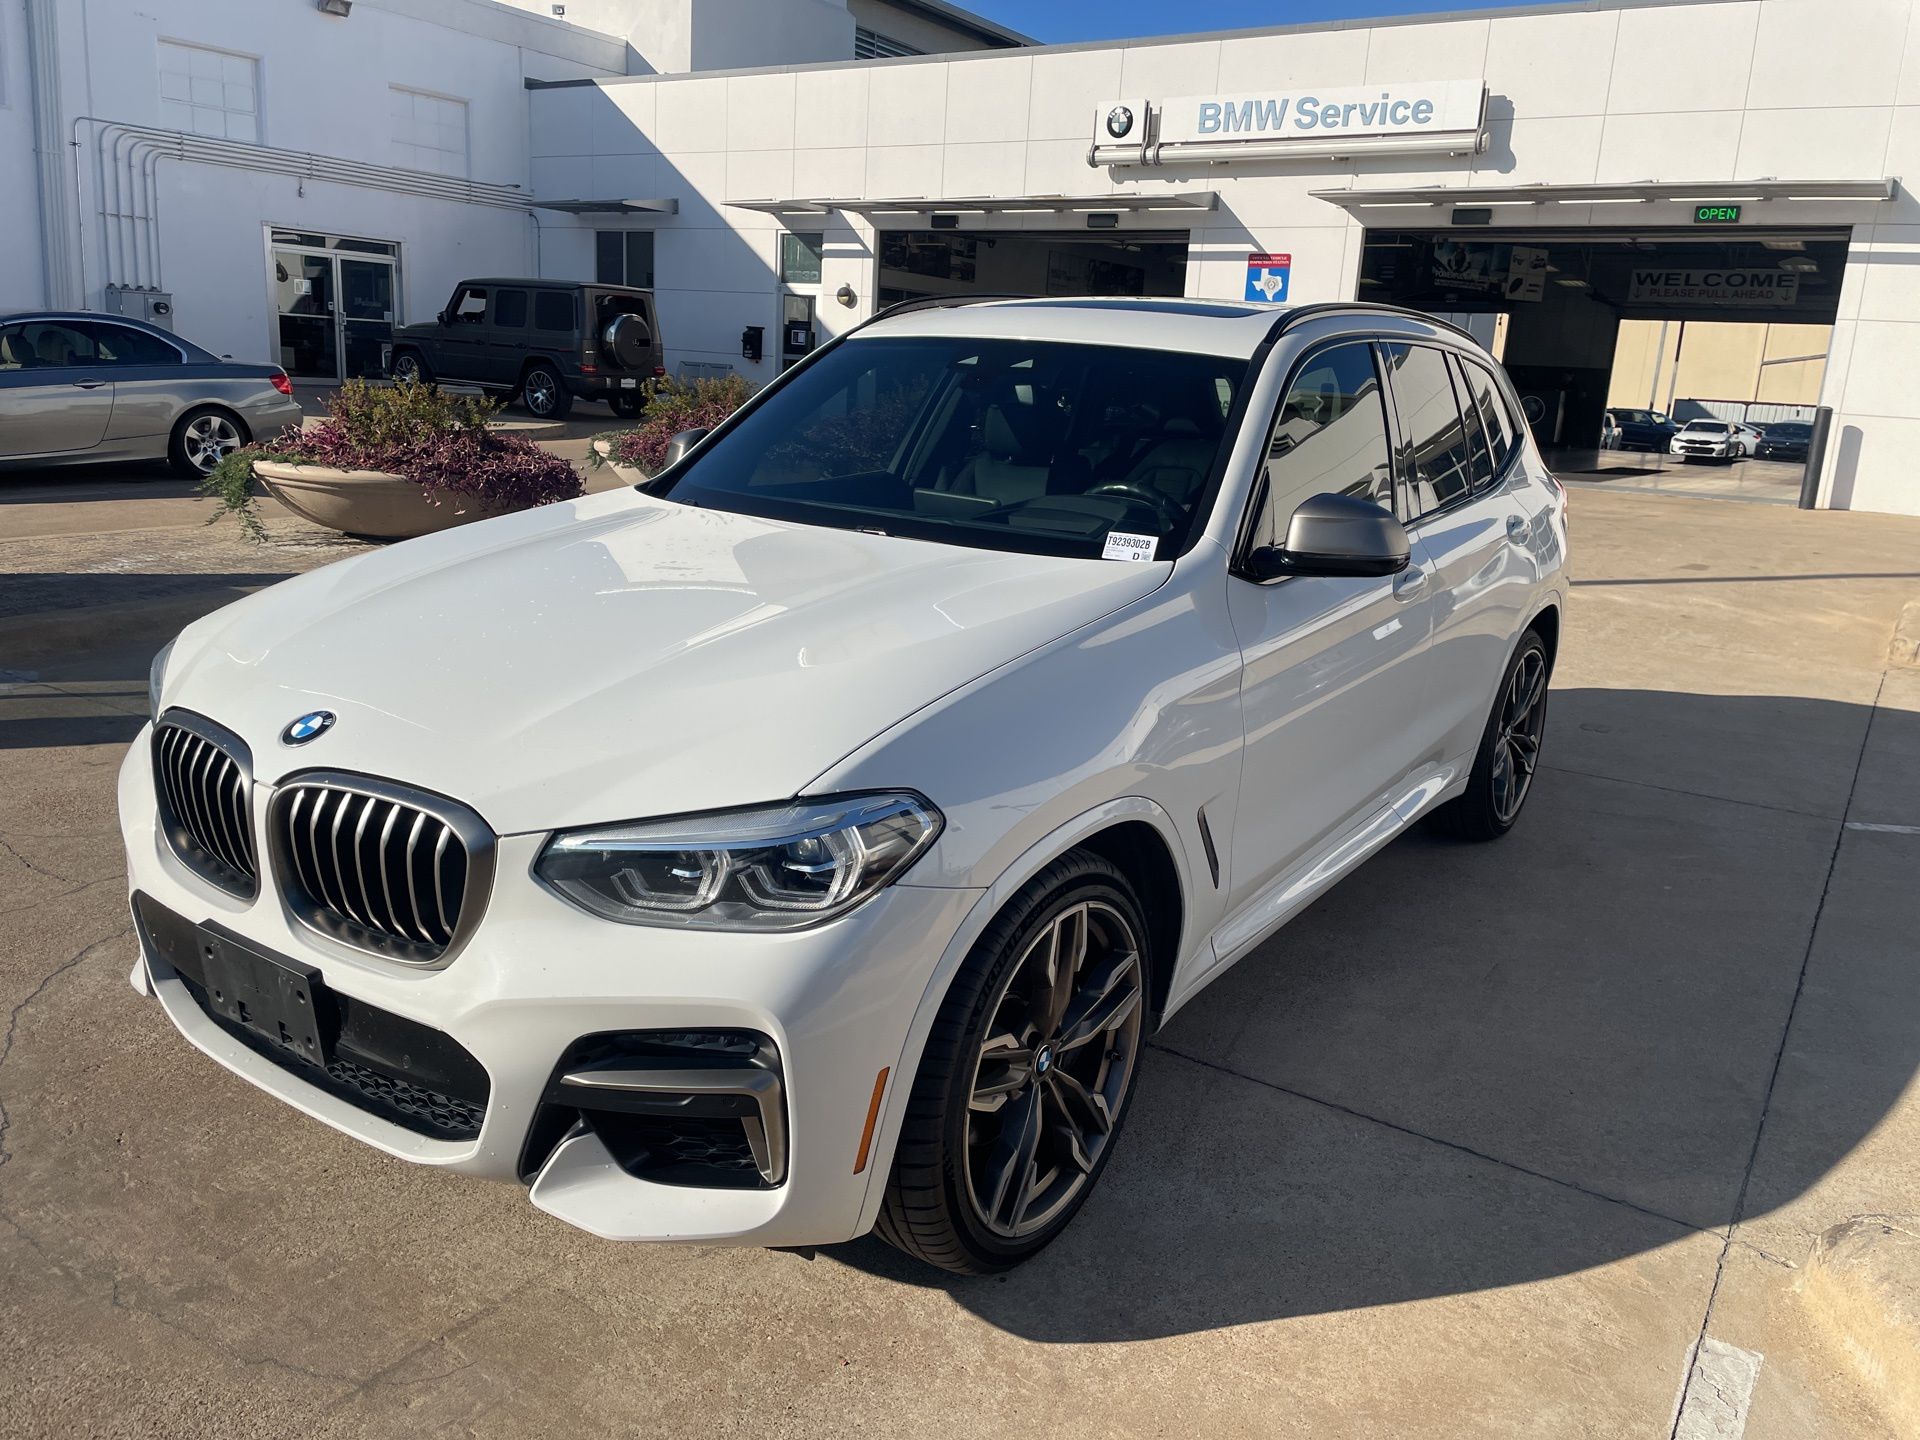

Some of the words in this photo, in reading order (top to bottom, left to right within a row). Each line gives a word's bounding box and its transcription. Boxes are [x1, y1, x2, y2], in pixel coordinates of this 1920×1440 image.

[1198, 98, 1289, 134] BMW
[1293, 93, 1434, 130] Service
[1698, 208, 1737, 220] OPEN
[1635, 272, 1796, 289] WELCOME
[1649, 288, 1695, 298] PLEASE
[1698, 288, 1729, 299] PULL
[1731, 289, 1774, 300] AHEAD
[1107, 536, 1151, 550] T9239302B
[1132, 552, 1140, 560] D
